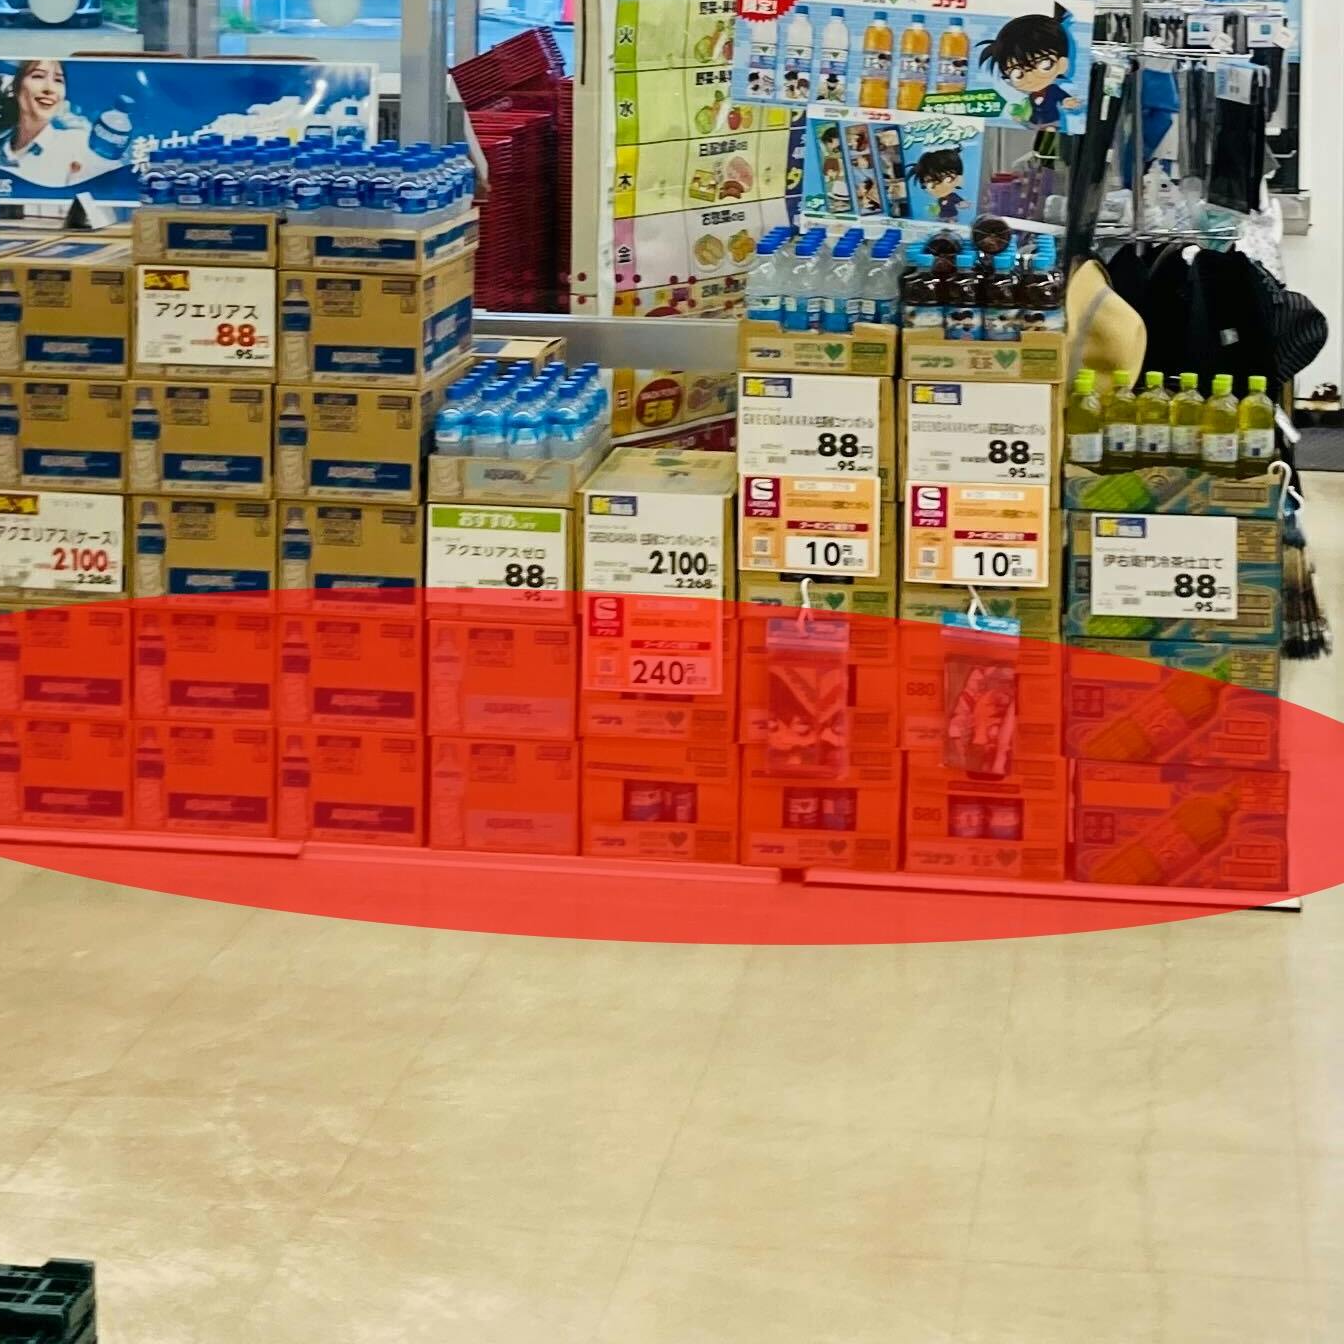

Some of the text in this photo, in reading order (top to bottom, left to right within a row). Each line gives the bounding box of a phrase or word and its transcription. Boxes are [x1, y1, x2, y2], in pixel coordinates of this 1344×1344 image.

[619, 27, 633, 44] 火
[619, 100, 634, 117] 水
[618, 174, 633, 189] 木
[156, 302, 259, 320] アクエリアス
[445, 543, 547, 560] アクエリアスゼロ
[1103, 554, 1224, 570] 伊右衛門冷茶仕立て
